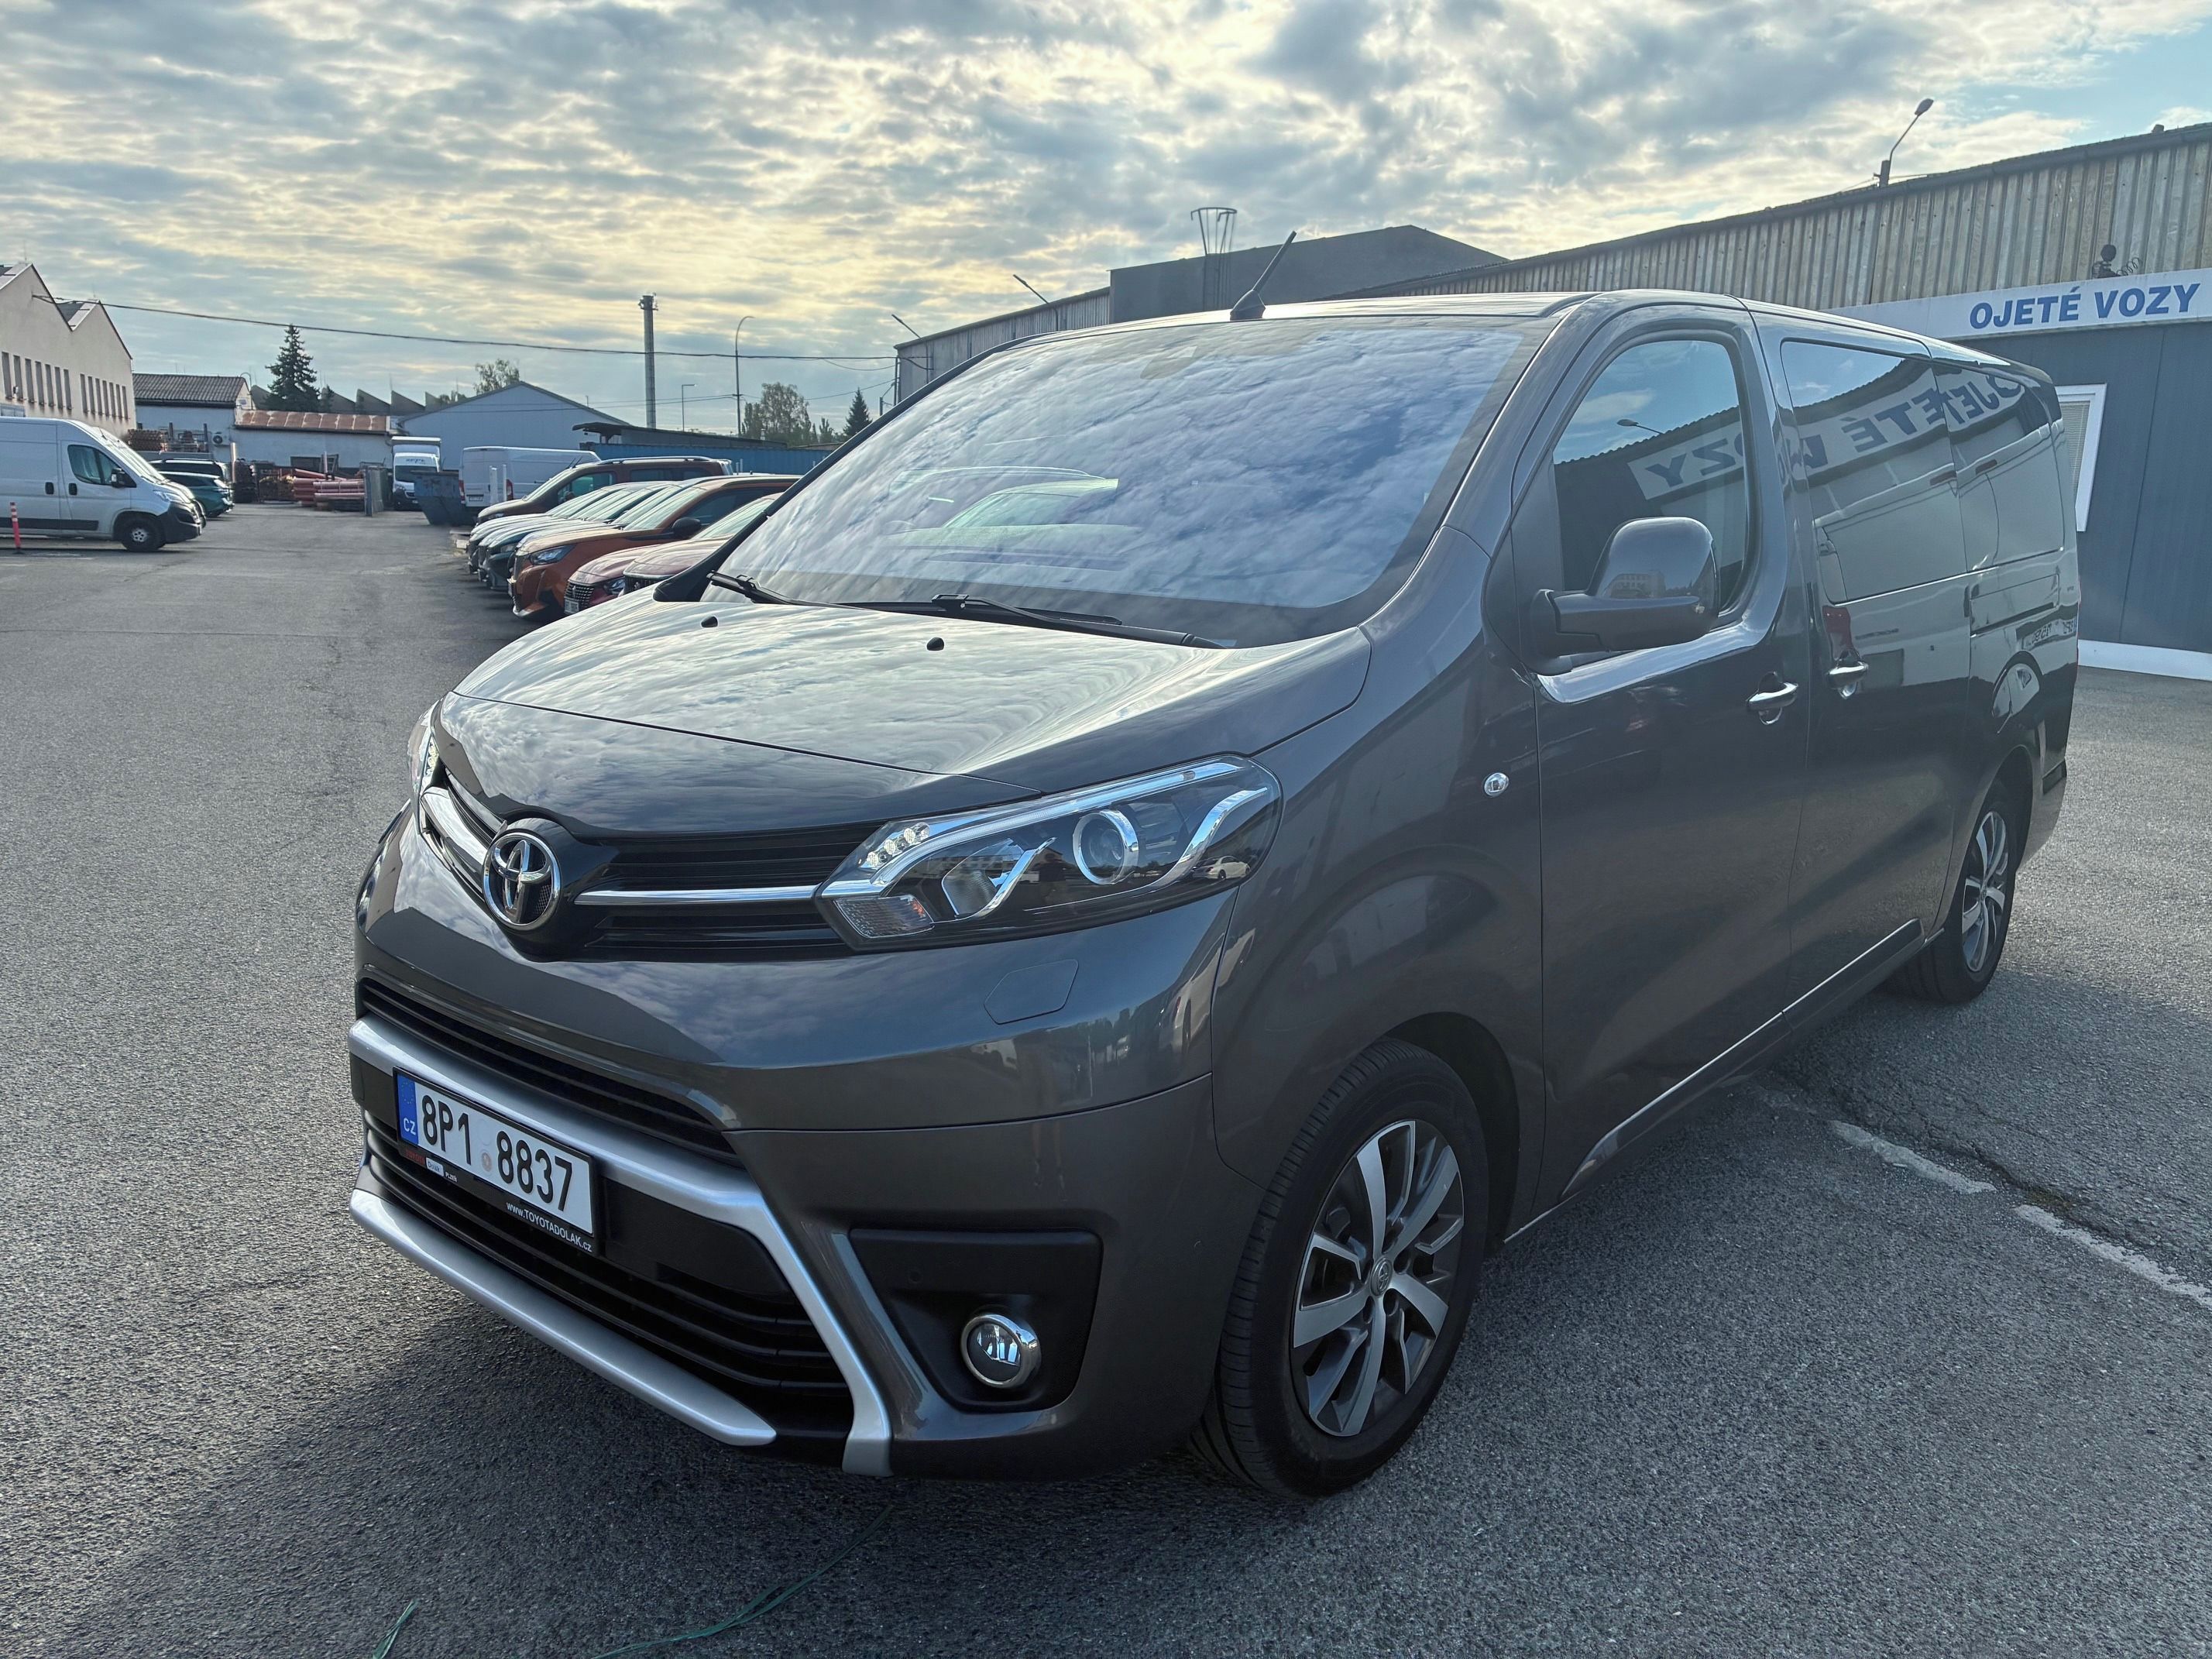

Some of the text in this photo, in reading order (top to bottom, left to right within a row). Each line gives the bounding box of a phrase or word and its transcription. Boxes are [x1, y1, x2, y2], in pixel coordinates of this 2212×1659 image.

[1970, 283, 2200, 329] OJETÉ VOZY
[404, 1118, 416, 1135] CZ
[422, 1095, 572, 1211] 8P1 8837
